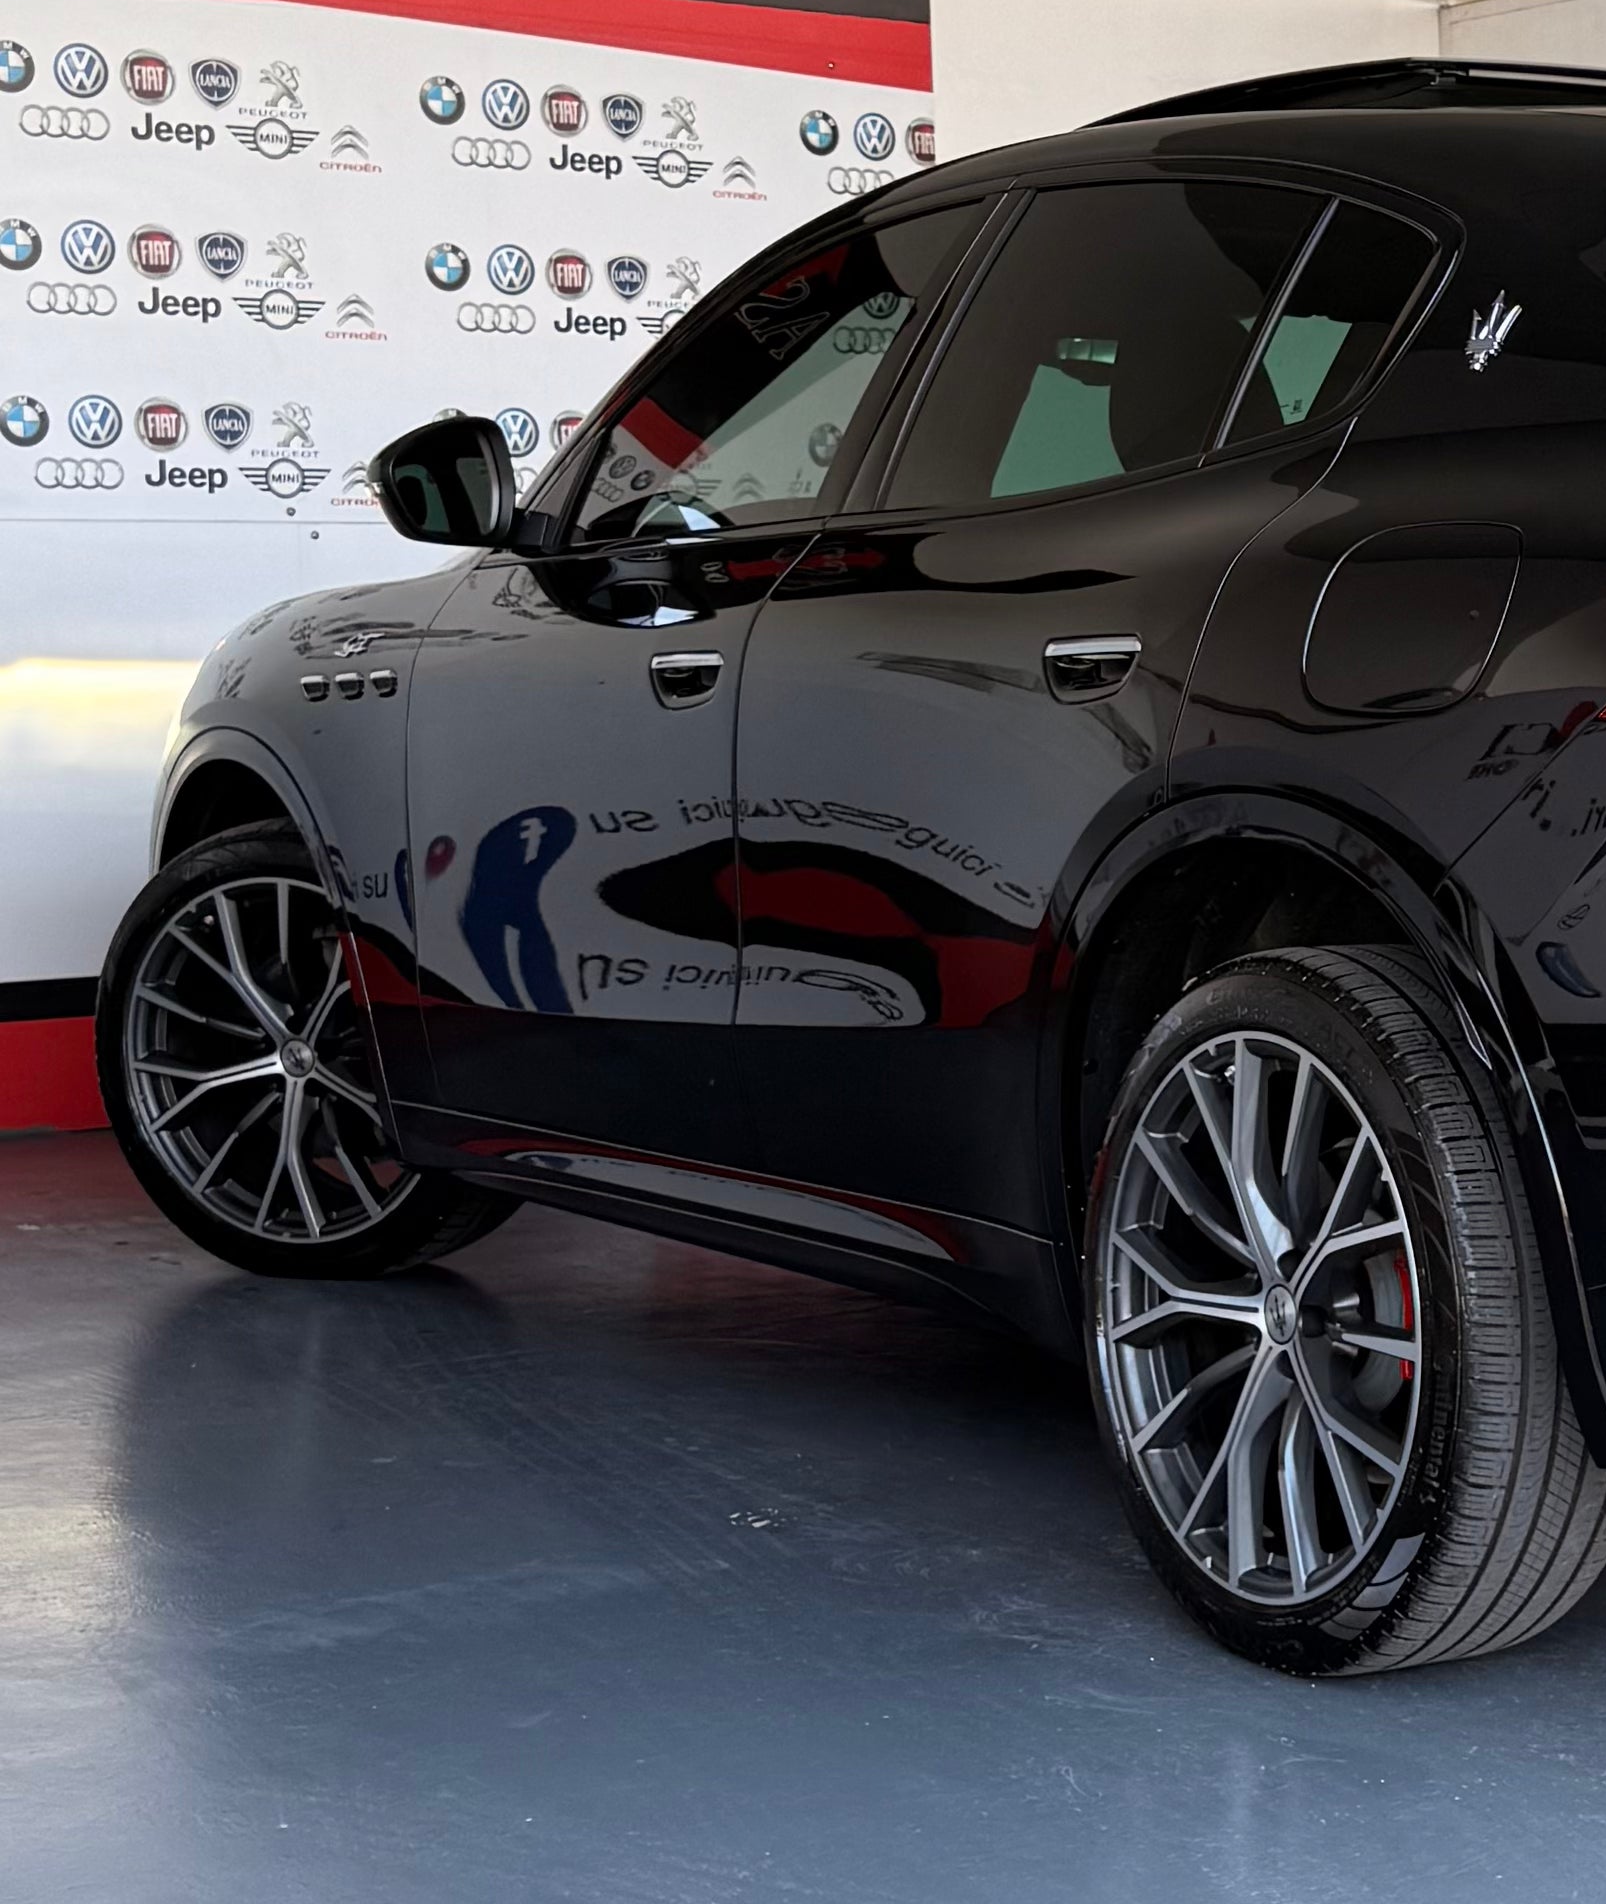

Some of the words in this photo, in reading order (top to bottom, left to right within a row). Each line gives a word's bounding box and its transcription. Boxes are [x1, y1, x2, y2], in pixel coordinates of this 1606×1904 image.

[134, 64, 165, 92] FIAT
[199, 72, 231, 90] LANCIA
[238, 106, 308, 120] PEUGEOT
[551, 99, 581, 125] FIAT
[608, 106, 637, 122] LANCIA
[131, 113, 216, 151] Jeep
[260, 131, 288, 145] MINI
[642, 139, 704, 151] PEUGEOT
[914, 130, 935, 155] FIA
[550, 144, 623, 180] Jeep
[661, 162, 687, 175] MINI
[140, 238, 173, 266] FIAT
[205, 245, 238, 263] LANCIA
[556, 262, 585, 287] FIAT
[613, 268, 642, 283] LANCIA
[245, 278, 313, 289] PEUGEOT
[138, 286, 222, 323] Jeep
[265, 302, 295, 316] MINI
[647, 299, 690, 308] PEUGE
[554, 307, 627, 341] Jeep
[147, 412, 179, 439] FIAT
[212, 416, 244, 433] LANCIA
[250, 448, 320, 458] PEUGEOT
[145, 459, 229, 494] Jeep
[271, 472, 301, 485] MINI
[330, 497, 379, 507] CITRO
